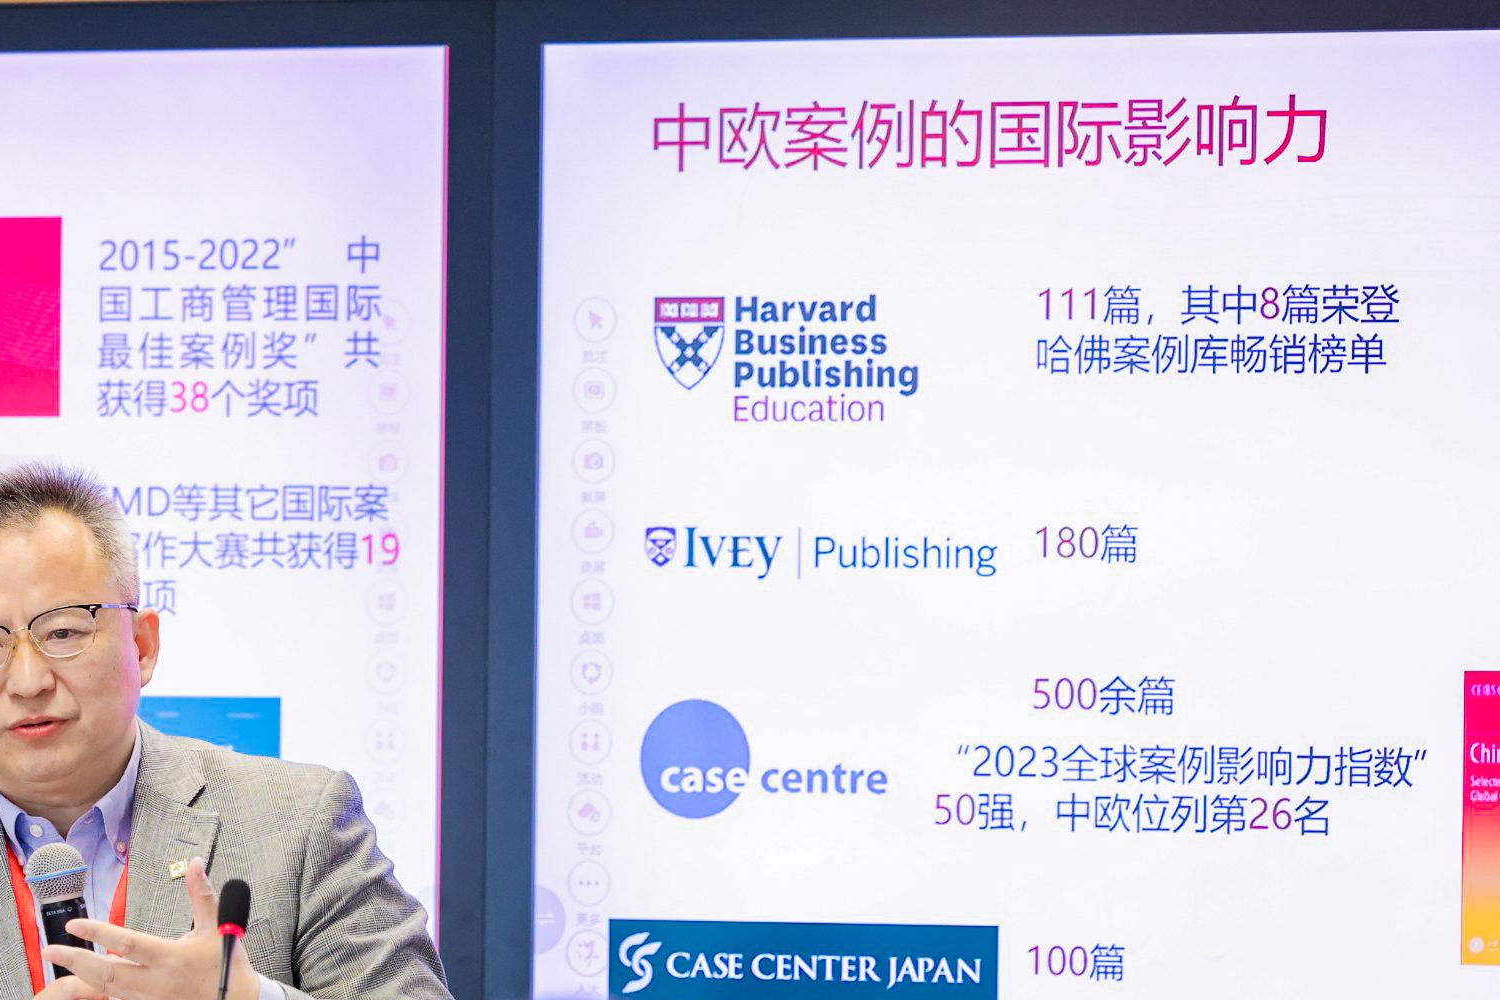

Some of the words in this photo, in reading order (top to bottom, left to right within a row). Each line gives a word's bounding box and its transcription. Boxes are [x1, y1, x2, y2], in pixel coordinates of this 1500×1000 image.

[654, 94, 1327, 172] 中欧案例的国际影响力
[100, 284, 381, 322] 国工商管理国际
[736, 295, 876, 322] Harvard
[1040, 284, 1399, 325] 111篇，其中8篇荣登
[735, 326, 887, 355] Business
[1038, 333, 1386, 374] 哈佛案例库畅销榜单
[735, 359, 918, 397] Publishing
[98, 379, 318, 417] 获得38个奖项
[734, 394, 883, 421] Education
[103, 484, 389, 521] MD等其它国际案
[132, 531, 400, 569] 作大赛共获得19
[815, 537, 997, 576] Publishing
[1036, 524, 1138, 563] 180篇
[1034, 676, 1175, 715] 500余篇
[659, 765, 747, 795] case
[761, 764, 887, 794] centre
[958, 745, 1426, 787] “2023全球案例影响力指数”
[936, 793, 1328, 836] 50强，中欧位列第26名
[667, 952, 743, 979] CASE
[751, 954, 880, 981] CENTER
[887, 957, 981, 988] JAPAN
[1029, 944, 1125, 981] 100篇
